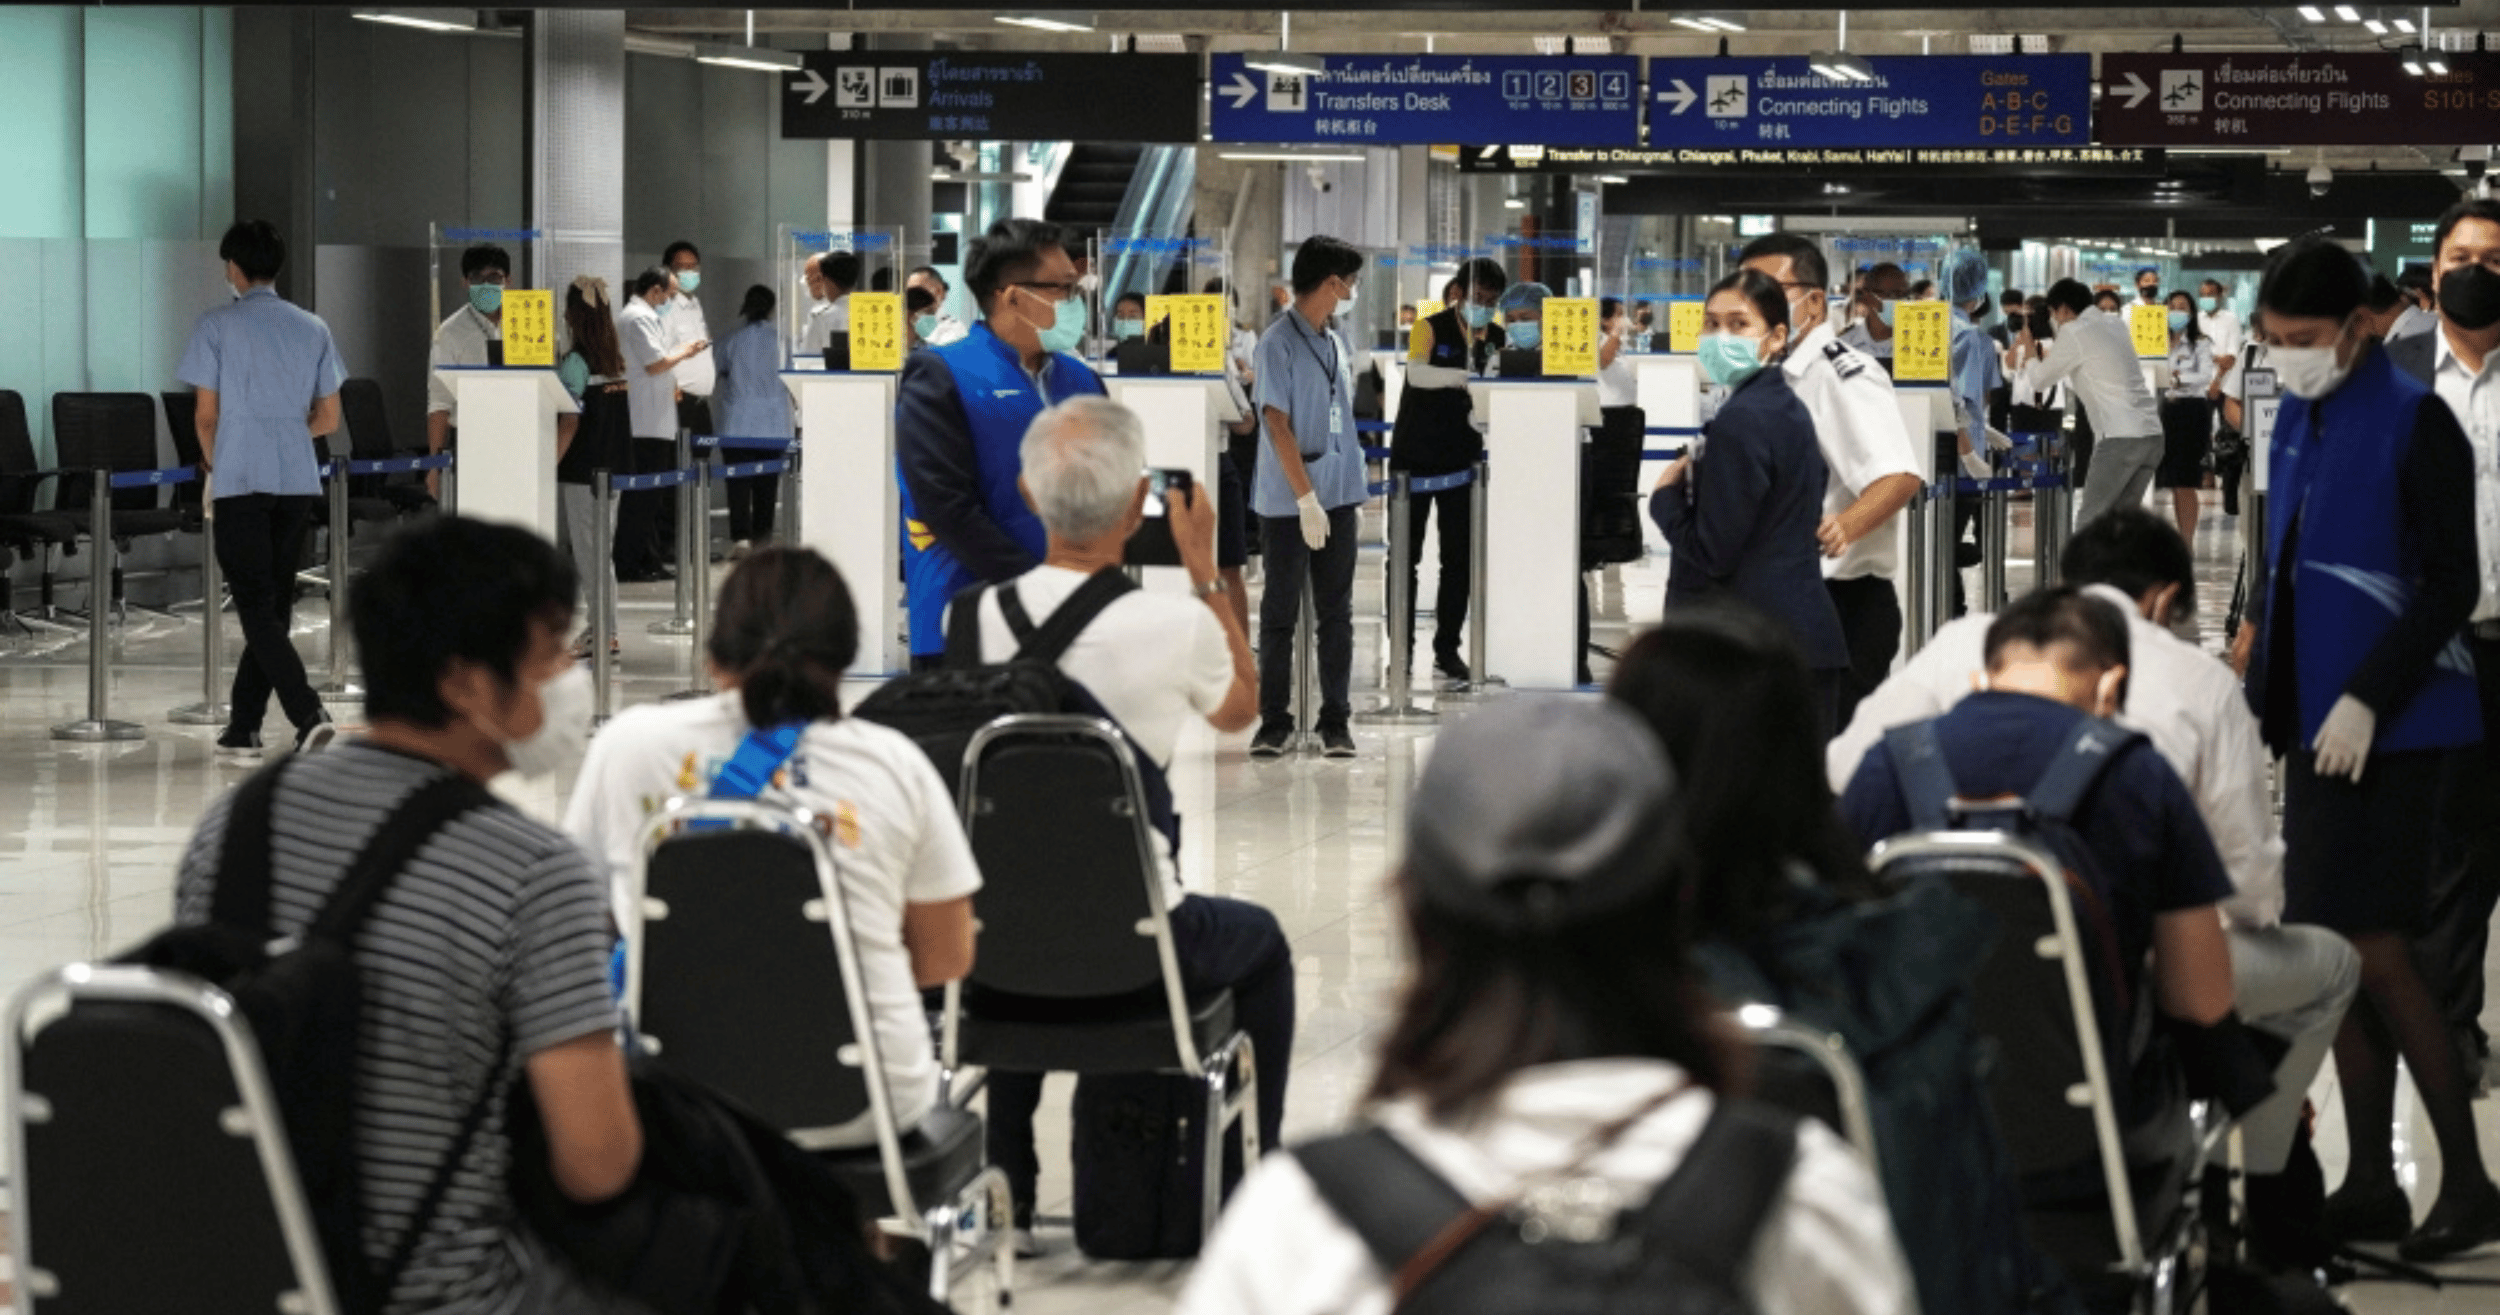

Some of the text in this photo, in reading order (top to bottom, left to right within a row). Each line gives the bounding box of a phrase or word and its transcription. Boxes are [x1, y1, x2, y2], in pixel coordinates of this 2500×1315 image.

[1512, 77, 1520, 94] 1
[1543, 76, 1556, 96] 2
[1575, 76, 1588, 95] 3
[1607, 76, 1621, 95] 4
[1982, 70, 2028, 85] Gates
[929, 90, 993, 107] Arrivals
[1315, 92, 1451, 110] Transfers Desk
[1759, 97, 1928, 118] Connecting Flights
[2214, 91, 2391, 113] Connecting Flights
[1548, 149, 1593, 161] Transfer
[1597, 149, 1608, 161] to
